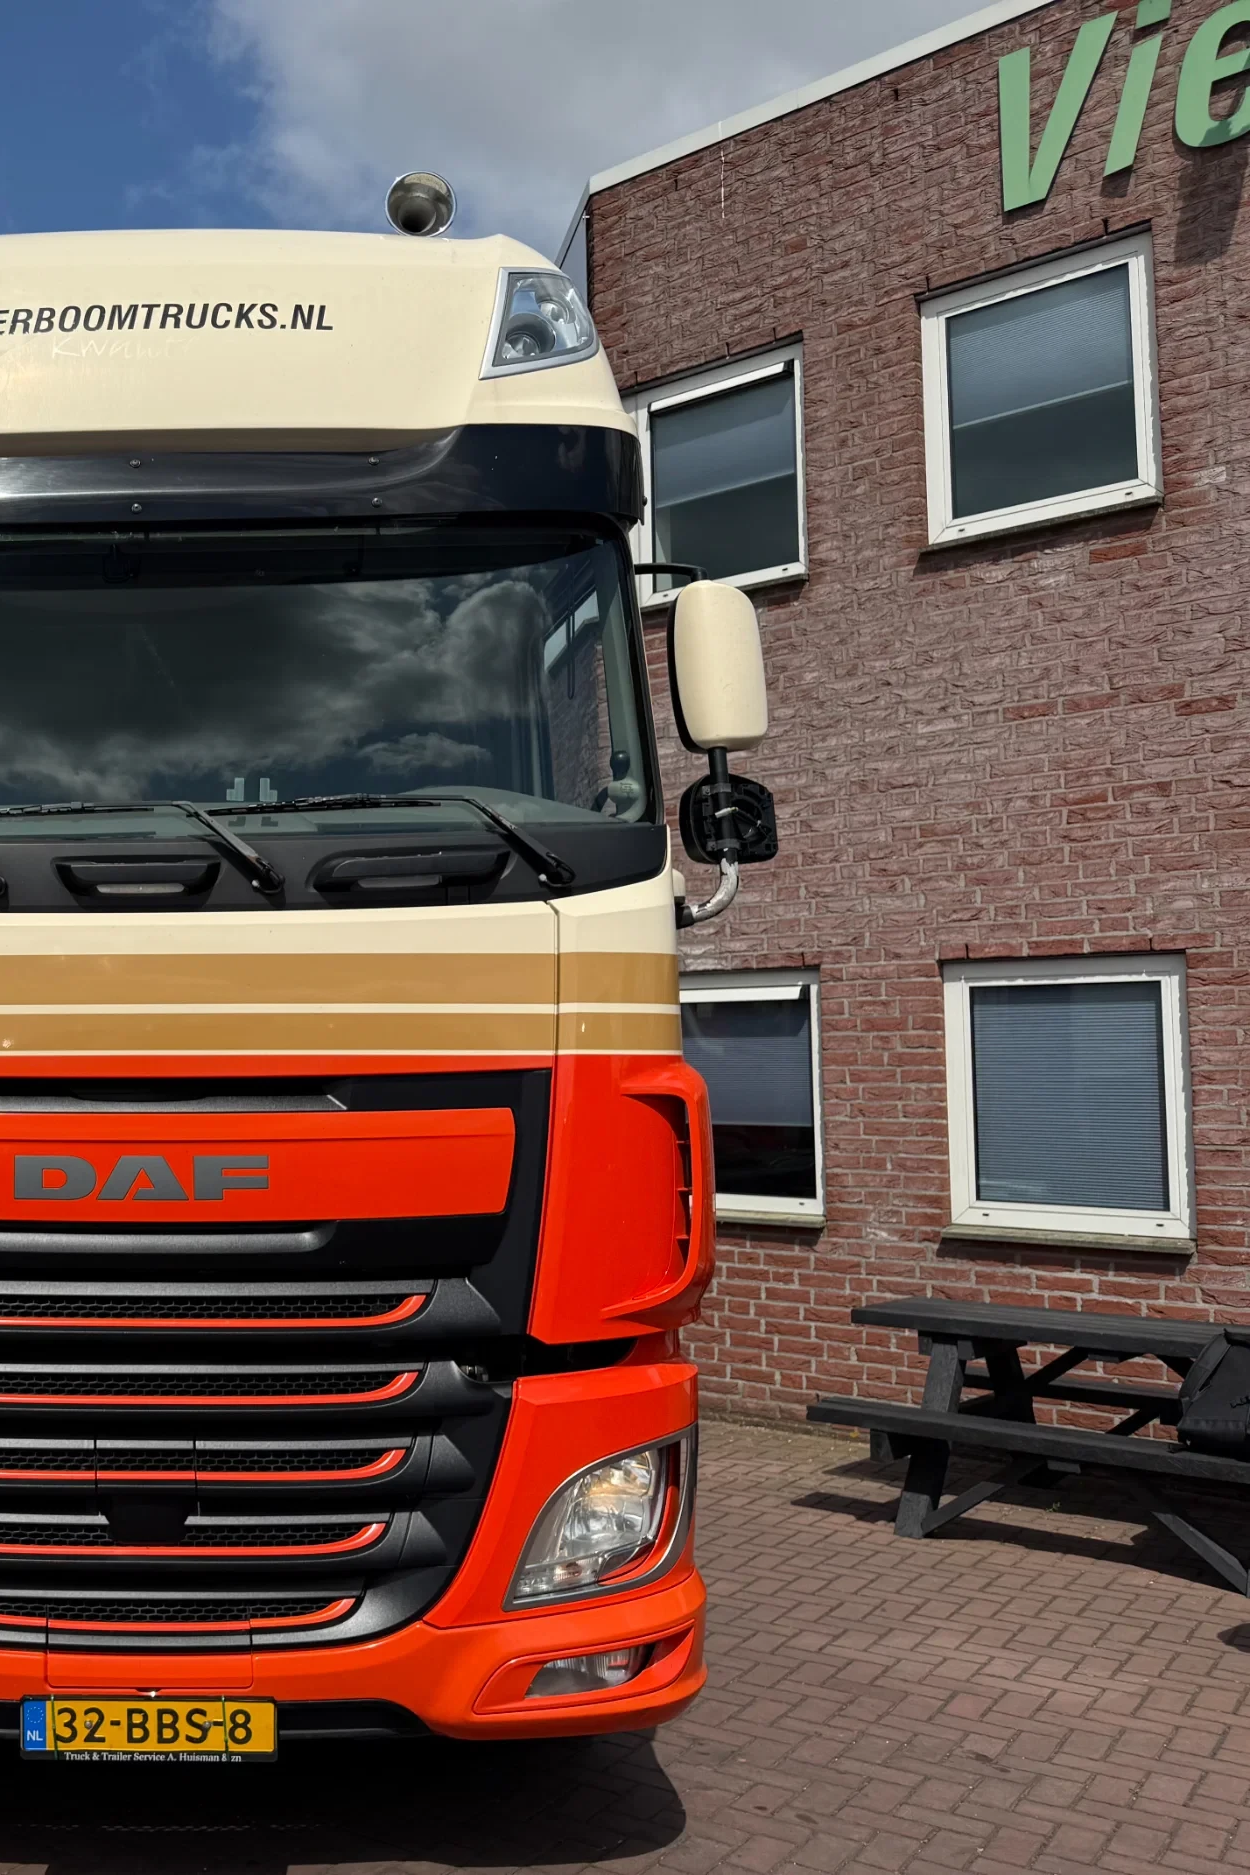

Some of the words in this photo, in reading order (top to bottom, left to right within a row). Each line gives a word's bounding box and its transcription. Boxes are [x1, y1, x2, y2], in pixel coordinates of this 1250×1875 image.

[13, 1154, 269, 1201] DAF
[26, 1729, 43, 1741] NL
[55, 1706, 253, 1744] 32-BBS-8
[64, 1751, 90, 1760] Truck
[92, 1751, 100, 1760] &
[101, 1751, 132, 1761] Trailer
[133, 1752, 166, 1761] Service
[167, 1752, 177, 1761] A.
[179, 1752, 220, 1762] Huisman
